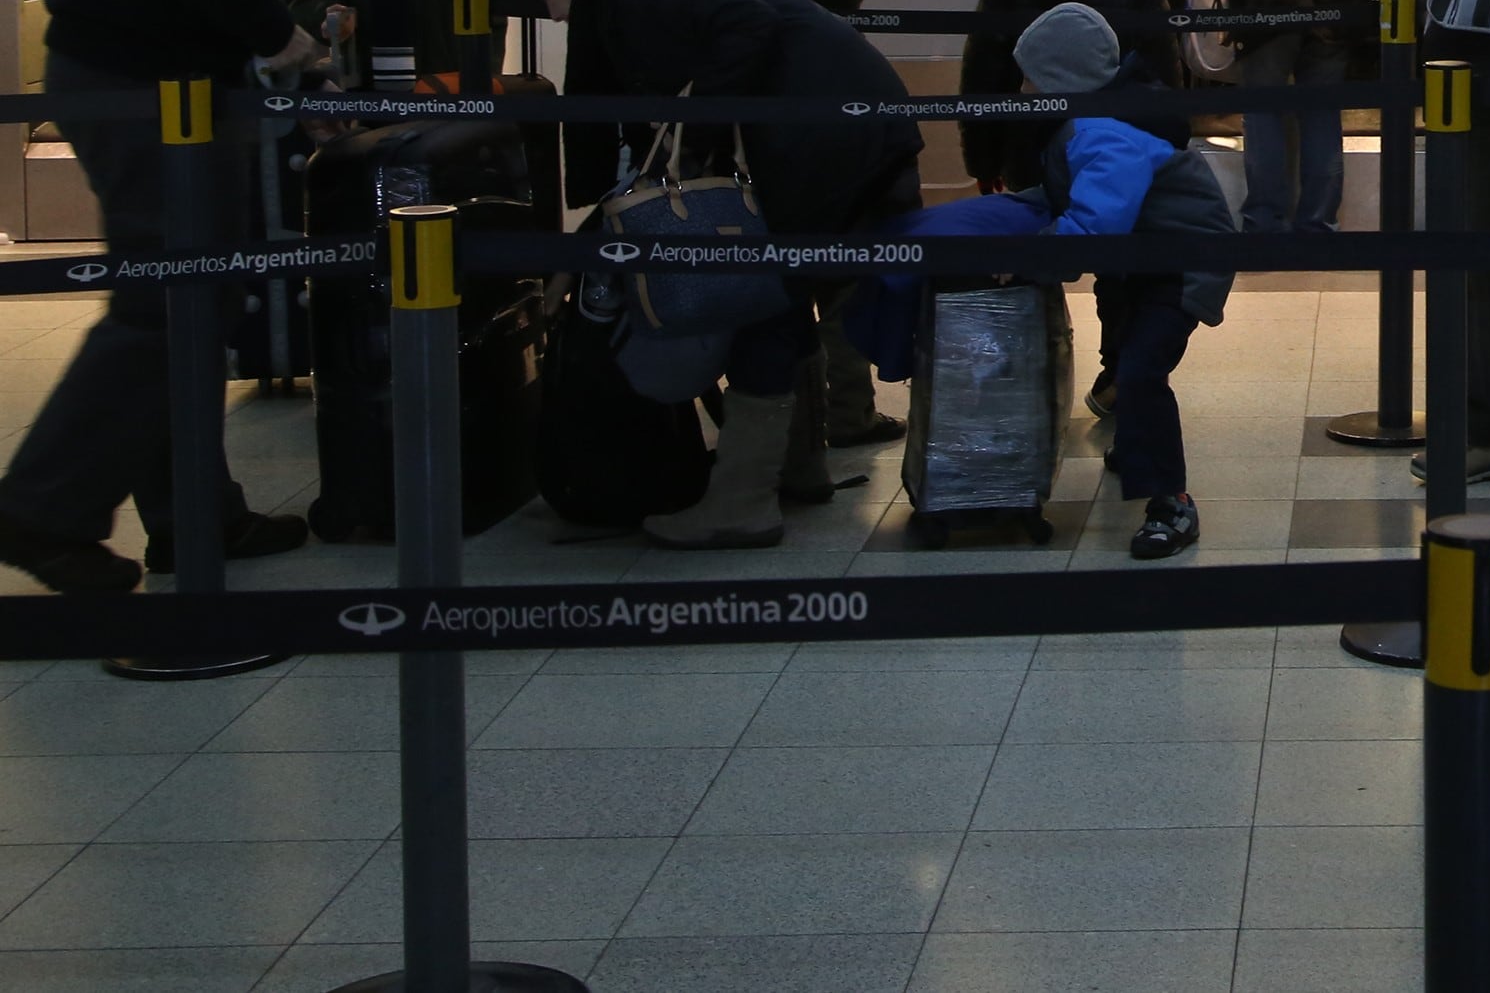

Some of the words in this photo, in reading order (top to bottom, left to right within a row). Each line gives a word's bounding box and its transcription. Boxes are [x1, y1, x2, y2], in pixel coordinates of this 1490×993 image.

[871, 14, 900, 26] 2000
[1255, 10, 1312, 25] Argentina
[1314, 9, 1341, 21] 2000
[300, 97, 378, 114] Aeropuertos
[379, 98, 456, 115] Argentina
[458, 100, 494, 113] 2000
[876, 101, 954, 117] Aeropuertos
[955, 99, 1031, 116] Argentina
[1032, 98, 1068, 111] 2000
[116, 254, 227, 280] Aeropuertos
[228, 246, 336, 273] Argentina
[339, 241, 376, 262] 200
[649, 242, 760, 266] Aeropuertos
[761, 243, 869, 267] Argentina
[872, 244, 923, 263] 2000
[421, 600, 602, 638] Aeropuertos
[605, 593, 782, 634] Argentina
[786, 591, 868, 624] 2000
